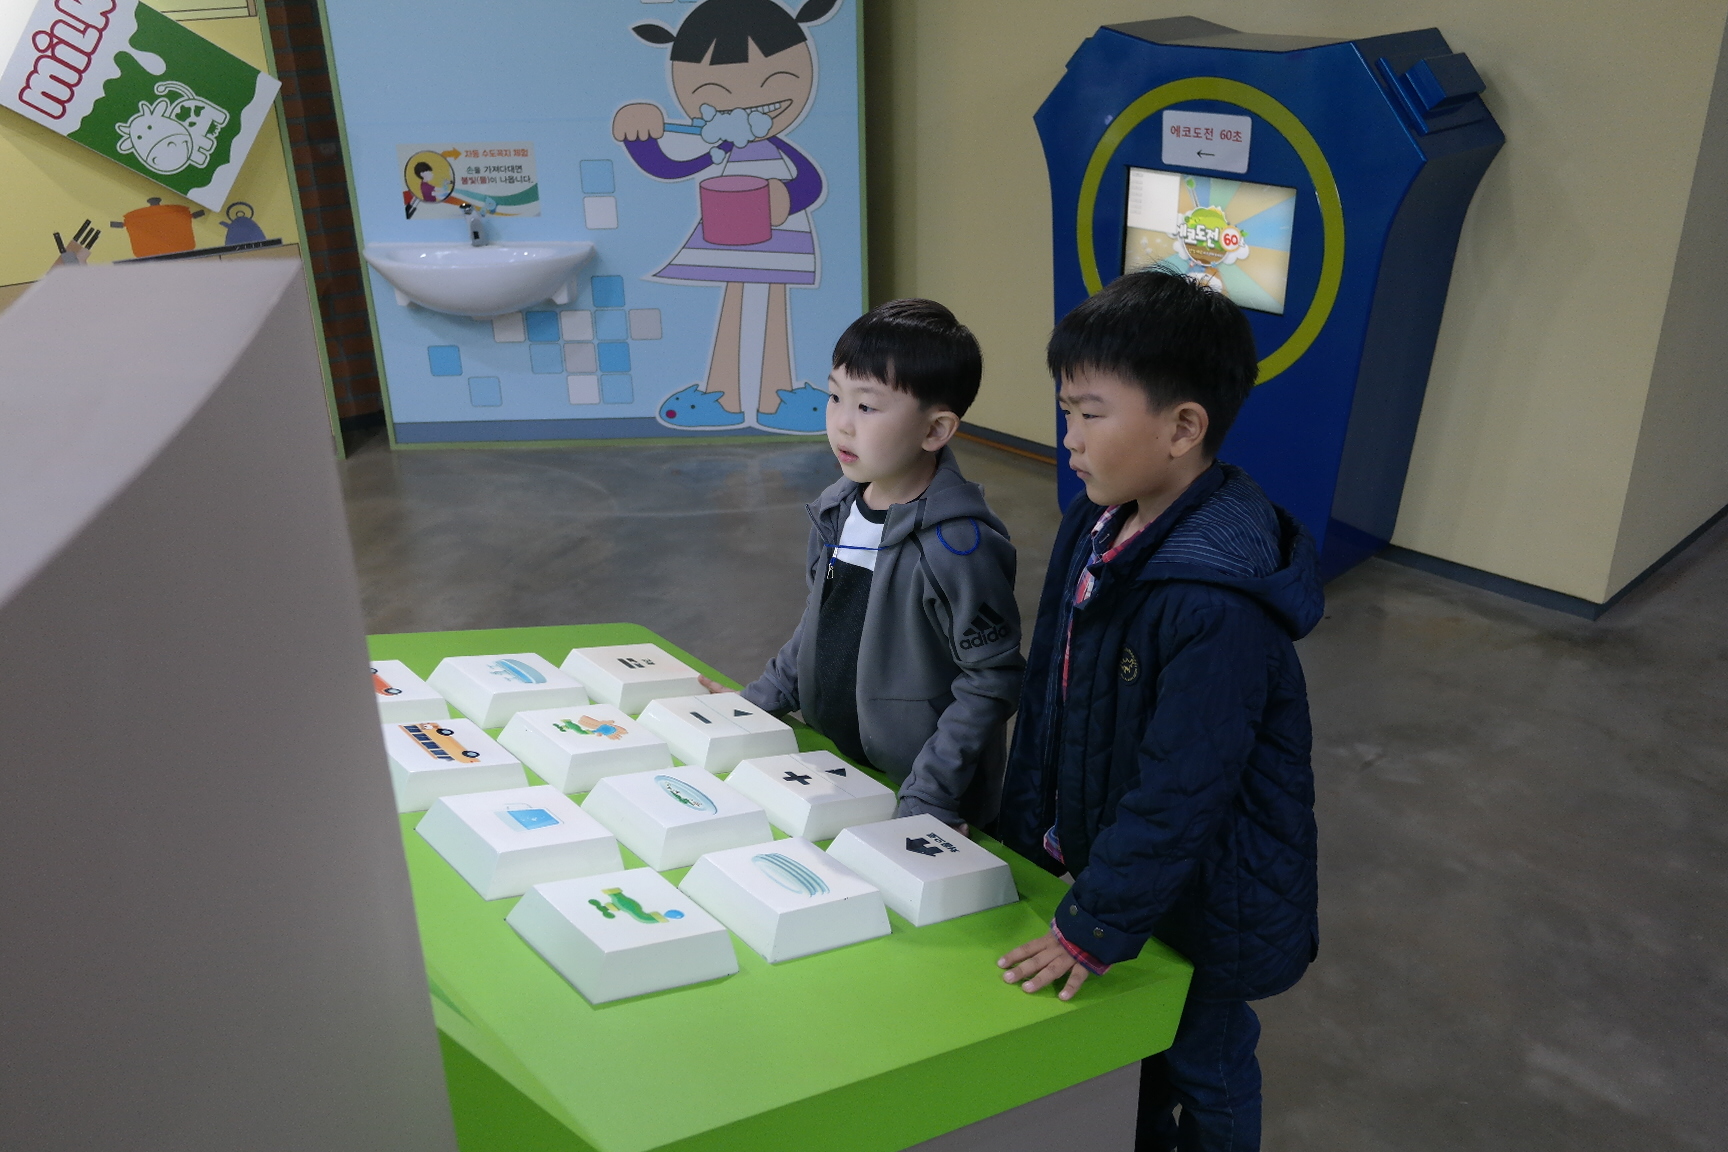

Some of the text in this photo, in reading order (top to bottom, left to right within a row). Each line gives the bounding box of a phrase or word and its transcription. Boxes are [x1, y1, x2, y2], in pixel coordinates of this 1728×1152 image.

[1170, 125, 1243, 143] 에코도전 60초
[464, 148, 529, 159] 자동 수도꼭지 체험
[466, 165, 481, 175] 손을
[960, 626, 1013, 650] adida
